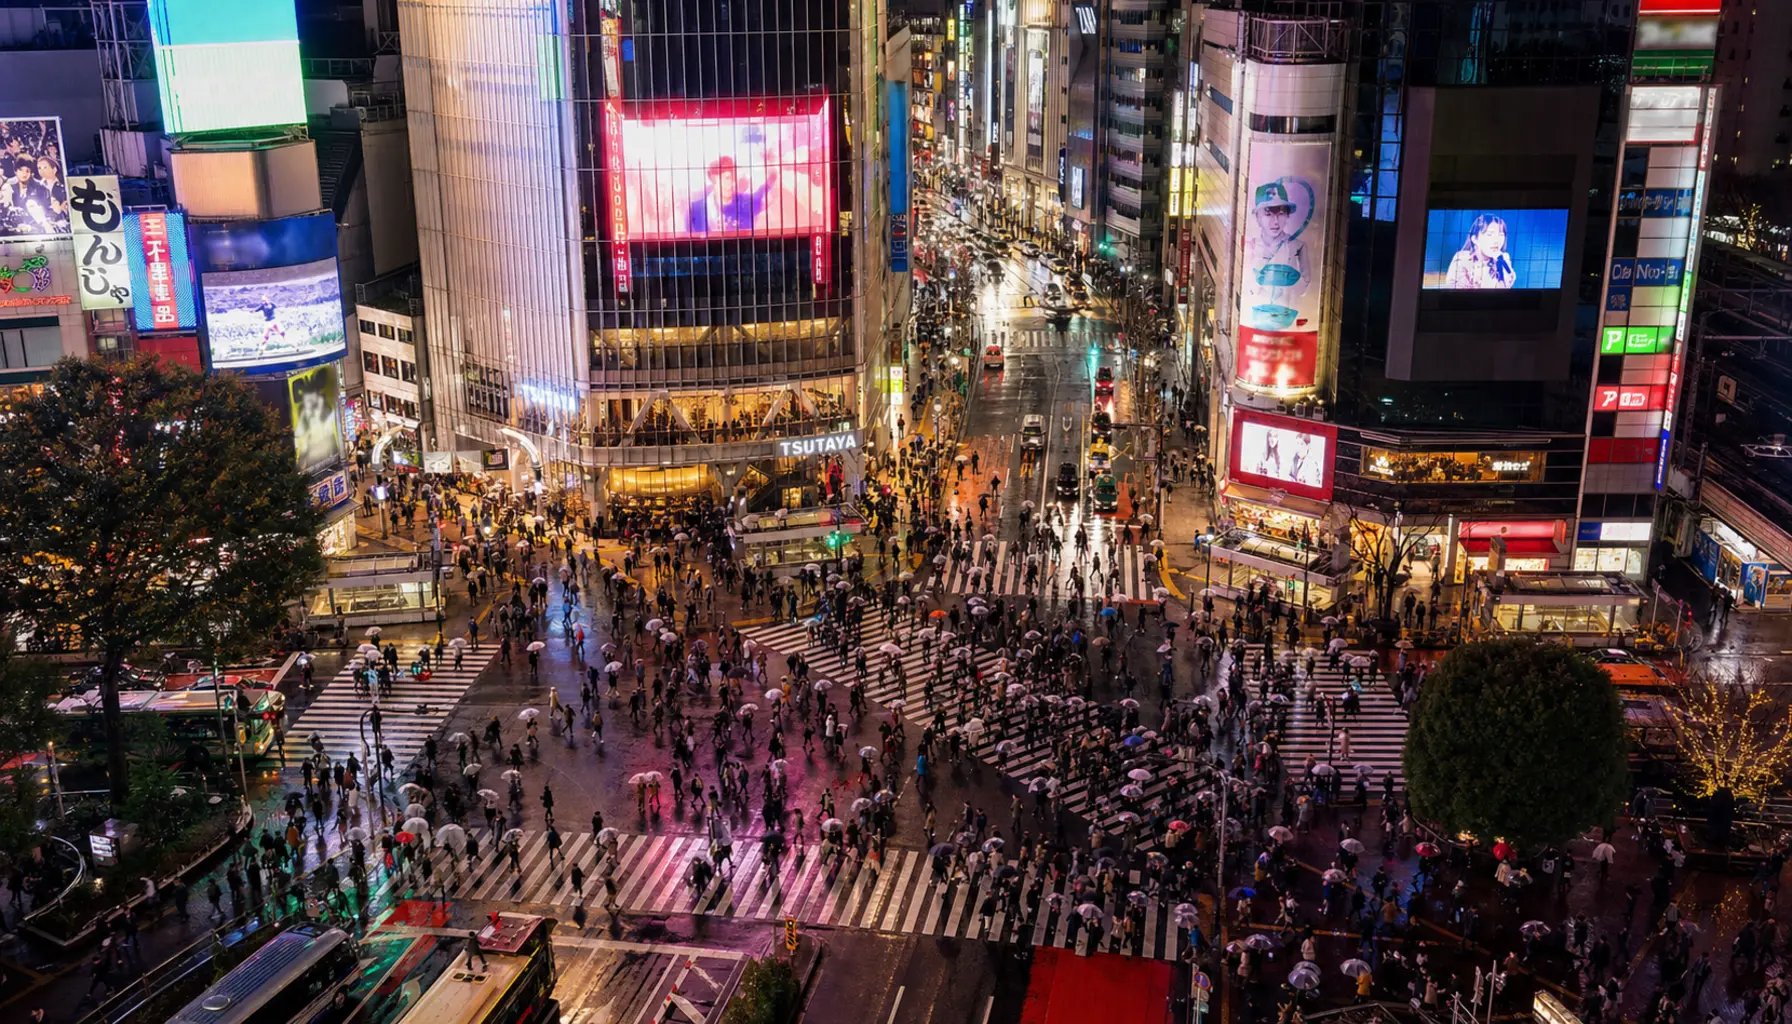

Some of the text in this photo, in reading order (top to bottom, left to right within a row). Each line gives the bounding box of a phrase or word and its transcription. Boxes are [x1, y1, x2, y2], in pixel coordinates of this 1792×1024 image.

[70, 178, 130, 304] もんじゃ
[780, 434, 857, 456] TSUTAYA
